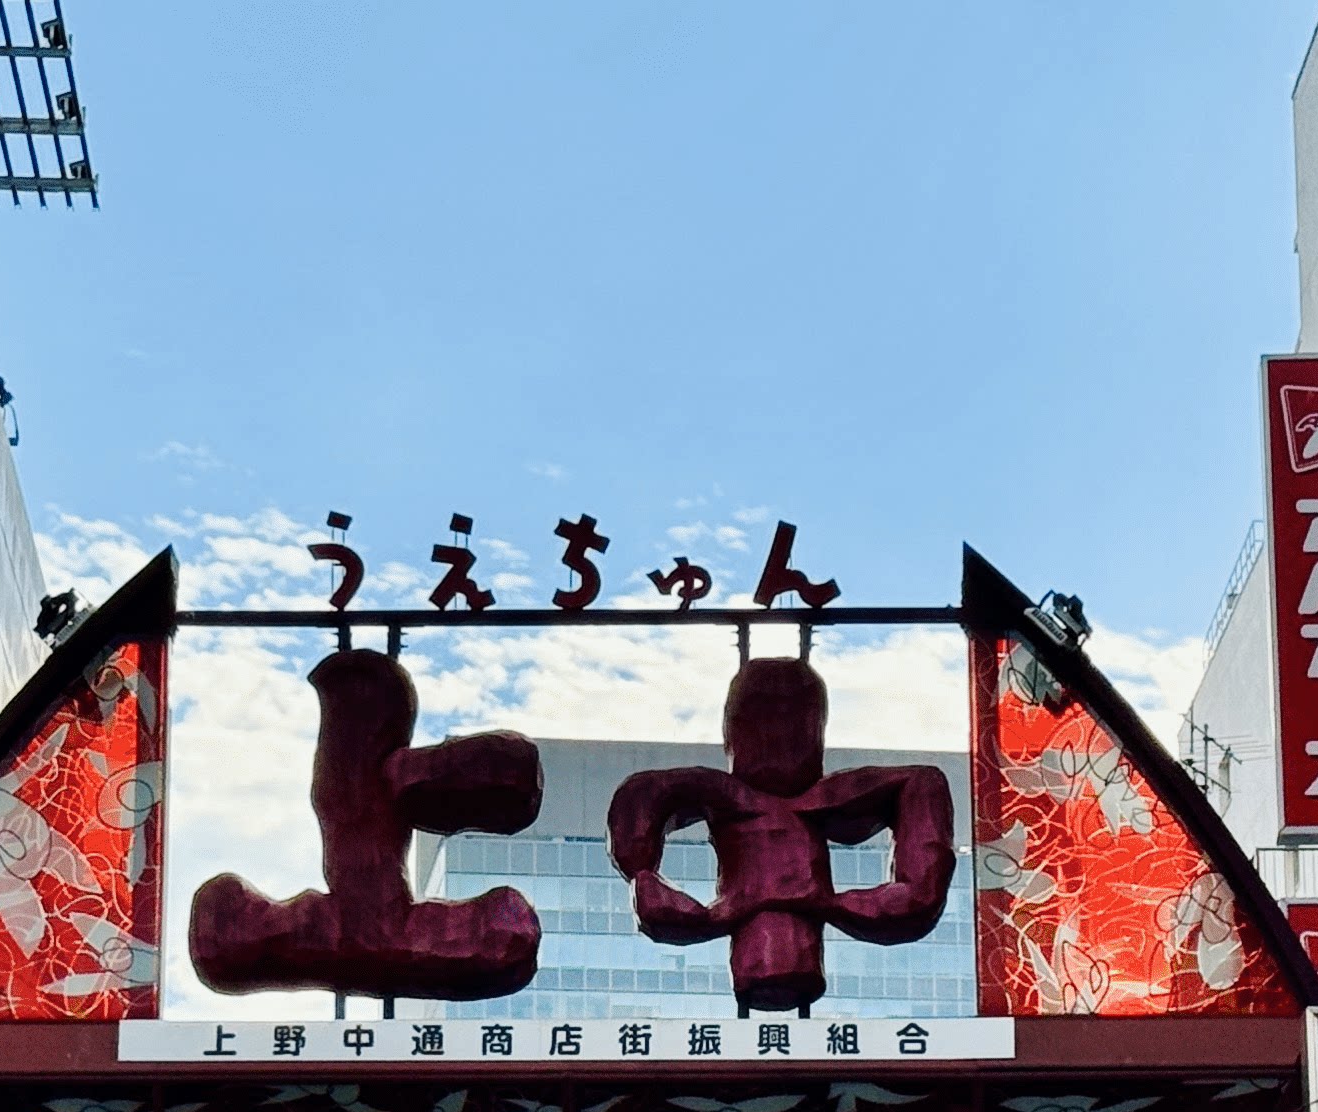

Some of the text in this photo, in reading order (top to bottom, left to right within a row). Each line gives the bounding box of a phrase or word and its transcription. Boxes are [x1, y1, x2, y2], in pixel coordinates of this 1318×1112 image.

[307, 511, 841, 611] うえちゅん
[189, 648, 955, 1012] 上中
[203, 1022, 932, 1058] 上野中通商店街振興組合
